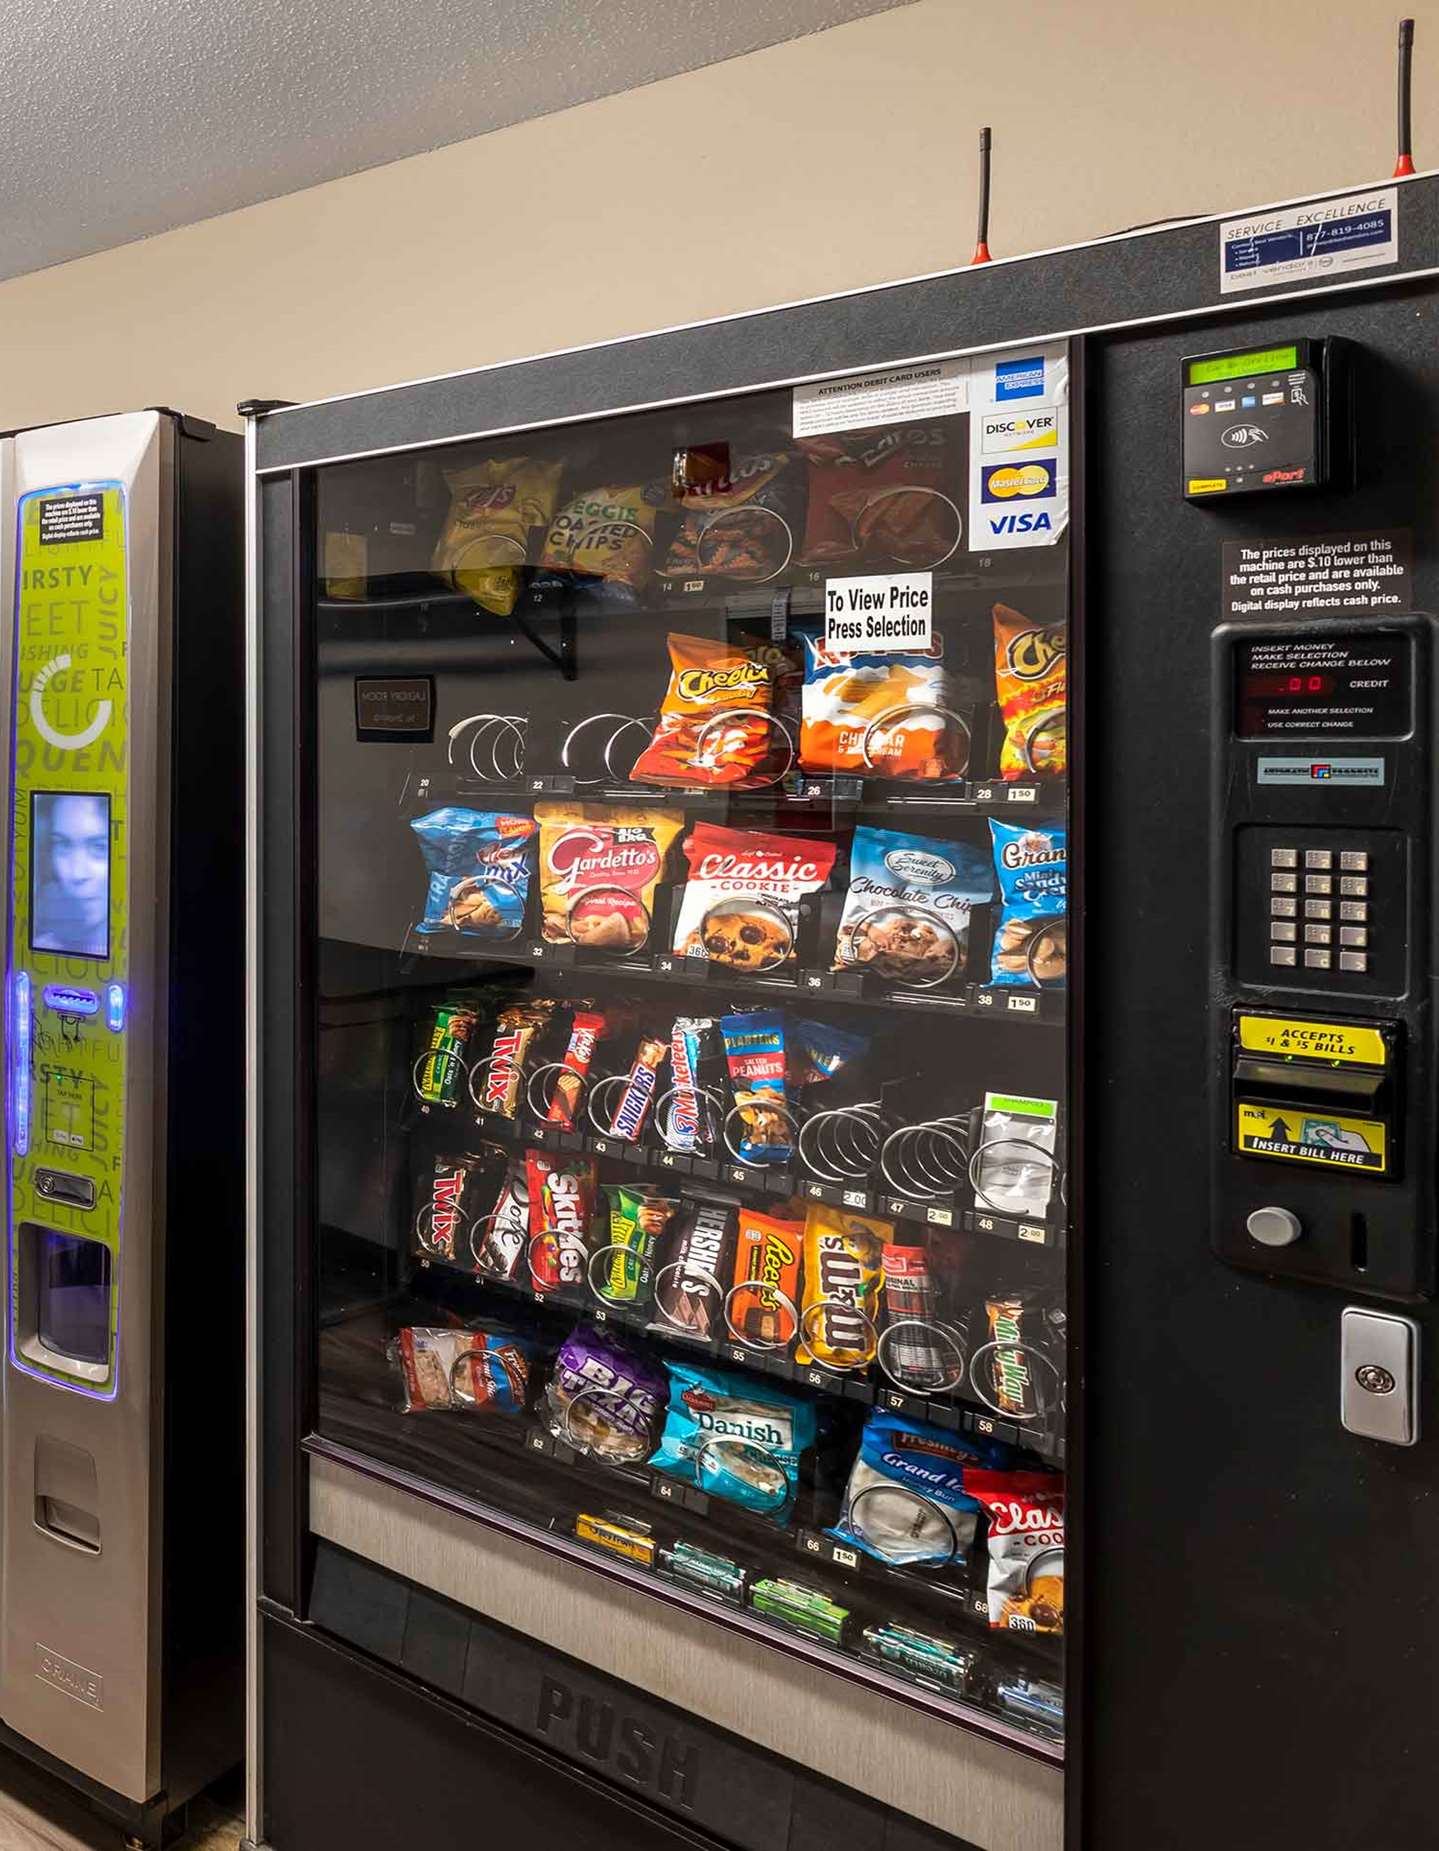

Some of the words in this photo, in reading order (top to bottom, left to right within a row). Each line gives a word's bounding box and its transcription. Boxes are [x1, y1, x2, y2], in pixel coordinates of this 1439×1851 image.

[1227, 219, 1283, 239] SERVICE
[1296, 198, 1386, 226] EXCELLENCE
[1306, 218, 1385, 241] 877-819-4085
[818, 381, 864, 396] ATTENTION
[863, 378, 889, 390] DEBIT
[888, 372, 914, 386] CARD
[914, 367, 942, 381] USERS
[1263, 467, 1305, 484] ePort
[989, 512, 1052, 535] VISA
[1241, 549, 1261, 560] The
[1262, 547, 1296, 563] prices
[1298, 542, 1351, 560] displayed
[1354, 543, 1368, 552] on
[1370, 539, 1392, 551] this
[1239, 560, 1285, 573] machine
[1287, 559, 1305, 569] are
[1333, 555, 1366, 567] lower
[1368, 552, 1393, 564] than
[1230, 574, 1247, 586] the
[1248, 572, 1276, 584] retail
[1278, 571, 1306, 586] price
[1308, 568, 1329, 581] and
[1331, 569, 1350, 579] are
[1353, 564, 1404, 578] available
[1250, 587, 1264, 597] on
[1266, 584, 1292, 595] cash
[1294, 581, 1352, 597] purchases
[1354, 579, 1381, 591] only.
[828, 590, 844, 612] To
[848, 588, 886, 611] View
[890, 585, 929, 608] Price
[1231, 600, 1262, 613] Digital
[1264, 598, 1300, 612] display
[1301, 597, 1340, 609] reflects
[1342, 596, 1368, 606] cash
[1370, 594, 1402, 608] price.
[98, 565, 119, 662] JUICY
[828, 618, 862, 640] Press
[866, 614, 926, 639] Selection
[1251, 645, 1292, 653] INSERT
[1293, 643, 1336, 651] MONEY
[1251, 653, 1282, 661] MAKE
[1285, 651, 1349, 660] SELECTION
[1251, 661, 1296, 670] RECEIVE
[1299, 660, 1345, 669] CHANGE
[1348, 658, 1392, 667] BELOW
[1349, 680, 1389, 688] CREDIT
[1291, 707, 1328, 715] ANOTHER
[839, 731, 905, 747] CHEAR
[533, 781, 543, 789] 22
[808, 786, 821, 796] 26
[977, 790, 992, 799] 28
[548, 832, 657, 896] Gardetto's
[699, 854, 818, 881] Classic
[896, 853, 941, 868] Sweet
[892, 864, 945, 882] Serenity
[719, 881, 791, 893] COOKIE
[850, 876, 930, 904] Chocolate
[533, 947, 543, 956] 32
[661, 962, 672, 970] 34
[808, 978, 821, 987] 36
[977, 995, 992, 1005] 38
[724, 1034, 781, 1049] PLANTERS
[1281, 1029, 1345, 1044] ACCEPTS
[1280, 1039, 1290, 1048] &
[1297, 1040, 1309, 1050] $5
[1314, 1043, 1356, 1055] BILLS
[486, 1029, 523, 1103] TWIX
[732, 1063, 784, 1078] PEANUTS
[671, 1031, 698, 1118] Muketeers
[673, 1114, 699, 1135] 3
[595, 1143, 606, 1152] 43
[1253, 1137, 1296, 1154] INSERT
[1299, 1146, 1326, 1159] BILL
[1330, 1151, 1365, 1165] HERE
[662, 1156, 673, 1166] 44
[733, 1170, 744, 1182] 45
[810, 1187, 821, 1197] 46
[432, 1170, 461, 1245] TWIX
[890, 1202, 904, 1213] 47
[547, 1172, 584, 1283] Skites
[979, 1219, 993, 1230] 48
[534, 1293, 544, 1303] 52
[595, 1310, 606, 1321] 53
[733, 1350, 745, 1361] 55
[809, 1372, 821, 1384] 56
[580, 1356, 658, 1417] BIG
[890, 1396, 904, 1407] 57
[697, 1411, 784, 1446] Danish
[978, 1420, 993, 1432] 58
[533, 1438, 543, 1449] 62
[882, 1452, 944, 1484] Grand
[660, 1486, 672, 1497] 64
[934, 1490, 956, 1503] Bun
[806, 1540, 820, 1552] 66
[975, 1600, 989, 1613] 68
[536, 1673, 702, 1810] PUSH
